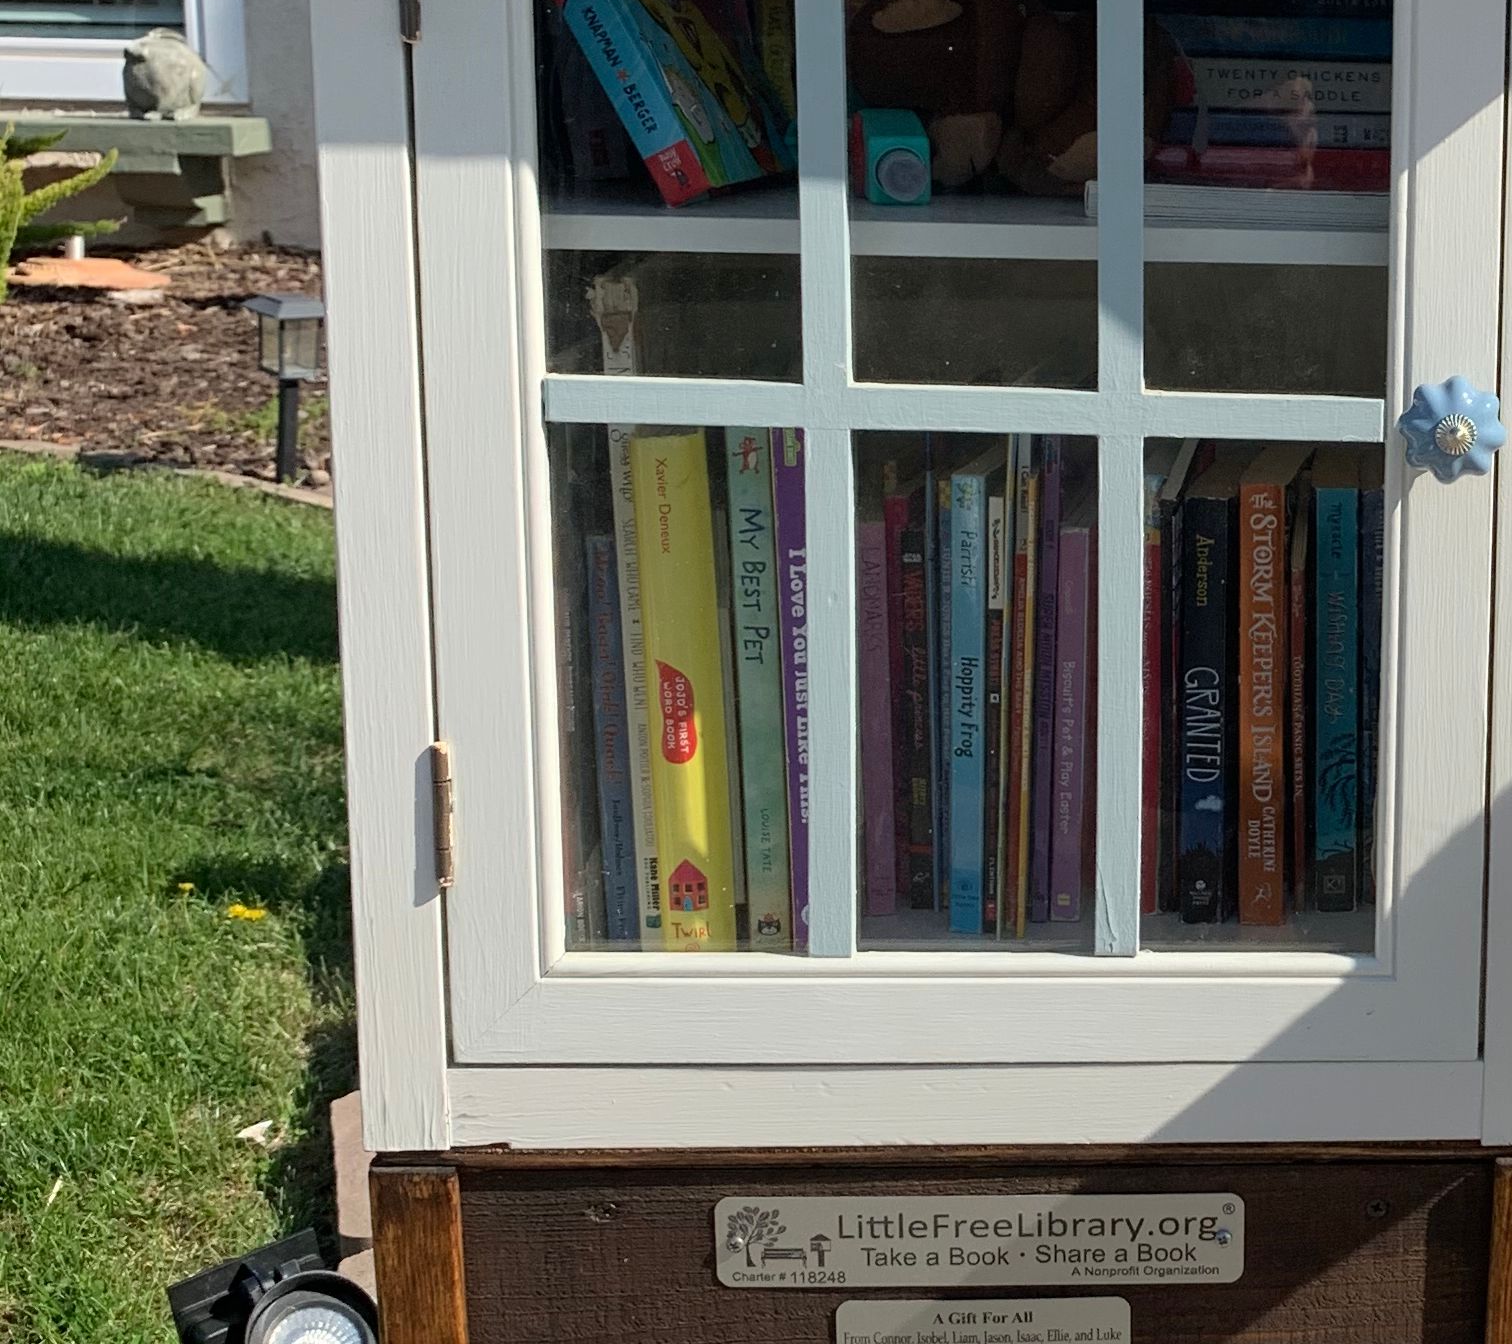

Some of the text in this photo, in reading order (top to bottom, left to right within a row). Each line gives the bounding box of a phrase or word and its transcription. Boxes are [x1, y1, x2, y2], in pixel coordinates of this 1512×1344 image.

[581, 4, 658, 136] KNAPMAN BERGER
[1207, 67, 1382, 83] TWENTY CHICKENS
[1226, 87, 1263, 100] FOR
[1290, 89, 1361, 103] SADDLE
[656, 457, 671, 554] Xavier Deneux
[739, 508, 770, 665] MY BEST PET
[1196, 534, 1215, 607] Anderson
[1249, 513, 1278, 602] STORM
[790, 562, 807, 617] Love
[793, 622, 808, 665] You
[663, 681, 676, 749] WORD BOOK
[675, 675, 690, 754] JOJO'S FIRST
[954, 656, 979, 758] Hoppity Frog
[1061, 660, 1075, 714] Biscuit's
[1183, 666, 1222, 783] GRANTED
[1250, 724, 1277, 803] ISLAND
[760, 808, 772, 874] LOUISE TATE
[1248, 819, 1261, 858] DOYLE
[1262, 805, 1275, 872] CATHERINE
[649, 857, 660, 911] Kane Miller
[732, 1271, 847, 1285] Charter # 118248
[860, 1243, 1198, 1267] Take a Book Share a Book
[1072, 1264, 1221, 1279] A Nonprofit Organization
[843, 1332, 871, 1344] From
[1074, 1328, 1094, 1342] and
[1096, 1327, 1123, 1342] Luke
[933, 1311, 1033, 1324] A Gift For All
